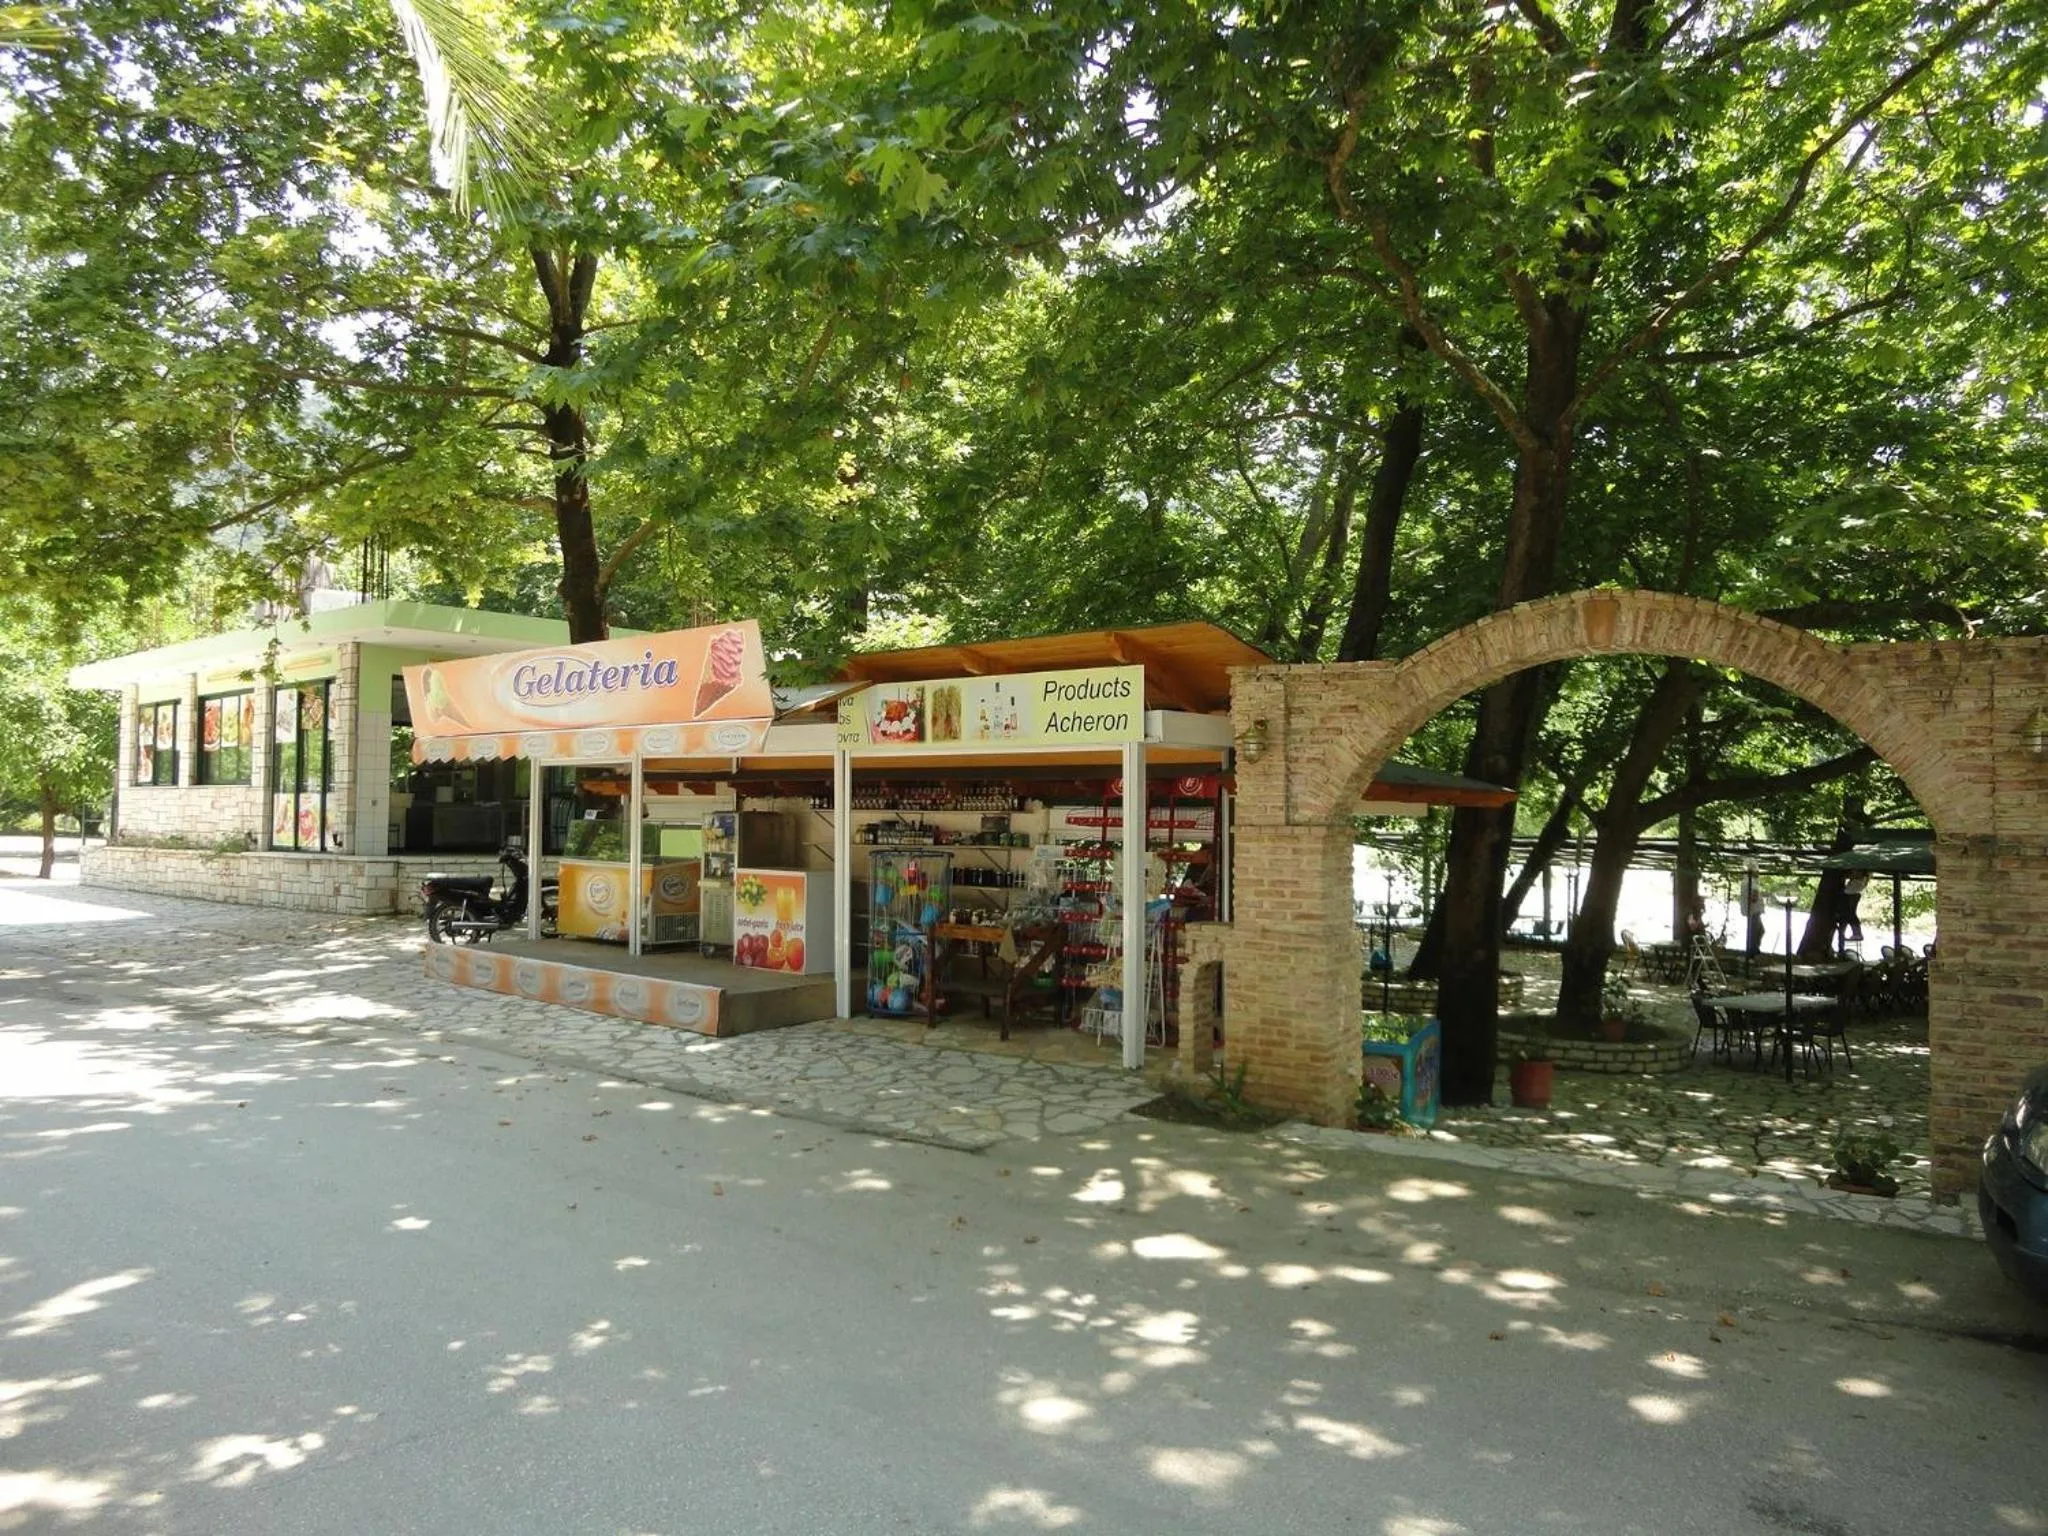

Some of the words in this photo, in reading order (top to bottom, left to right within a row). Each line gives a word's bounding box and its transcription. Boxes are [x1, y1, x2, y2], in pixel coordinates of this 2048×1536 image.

[512, 650, 679, 699] Gelateria
[1042, 677, 1131, 702] Products
[1044, 711, 1129, 733] Acheron
